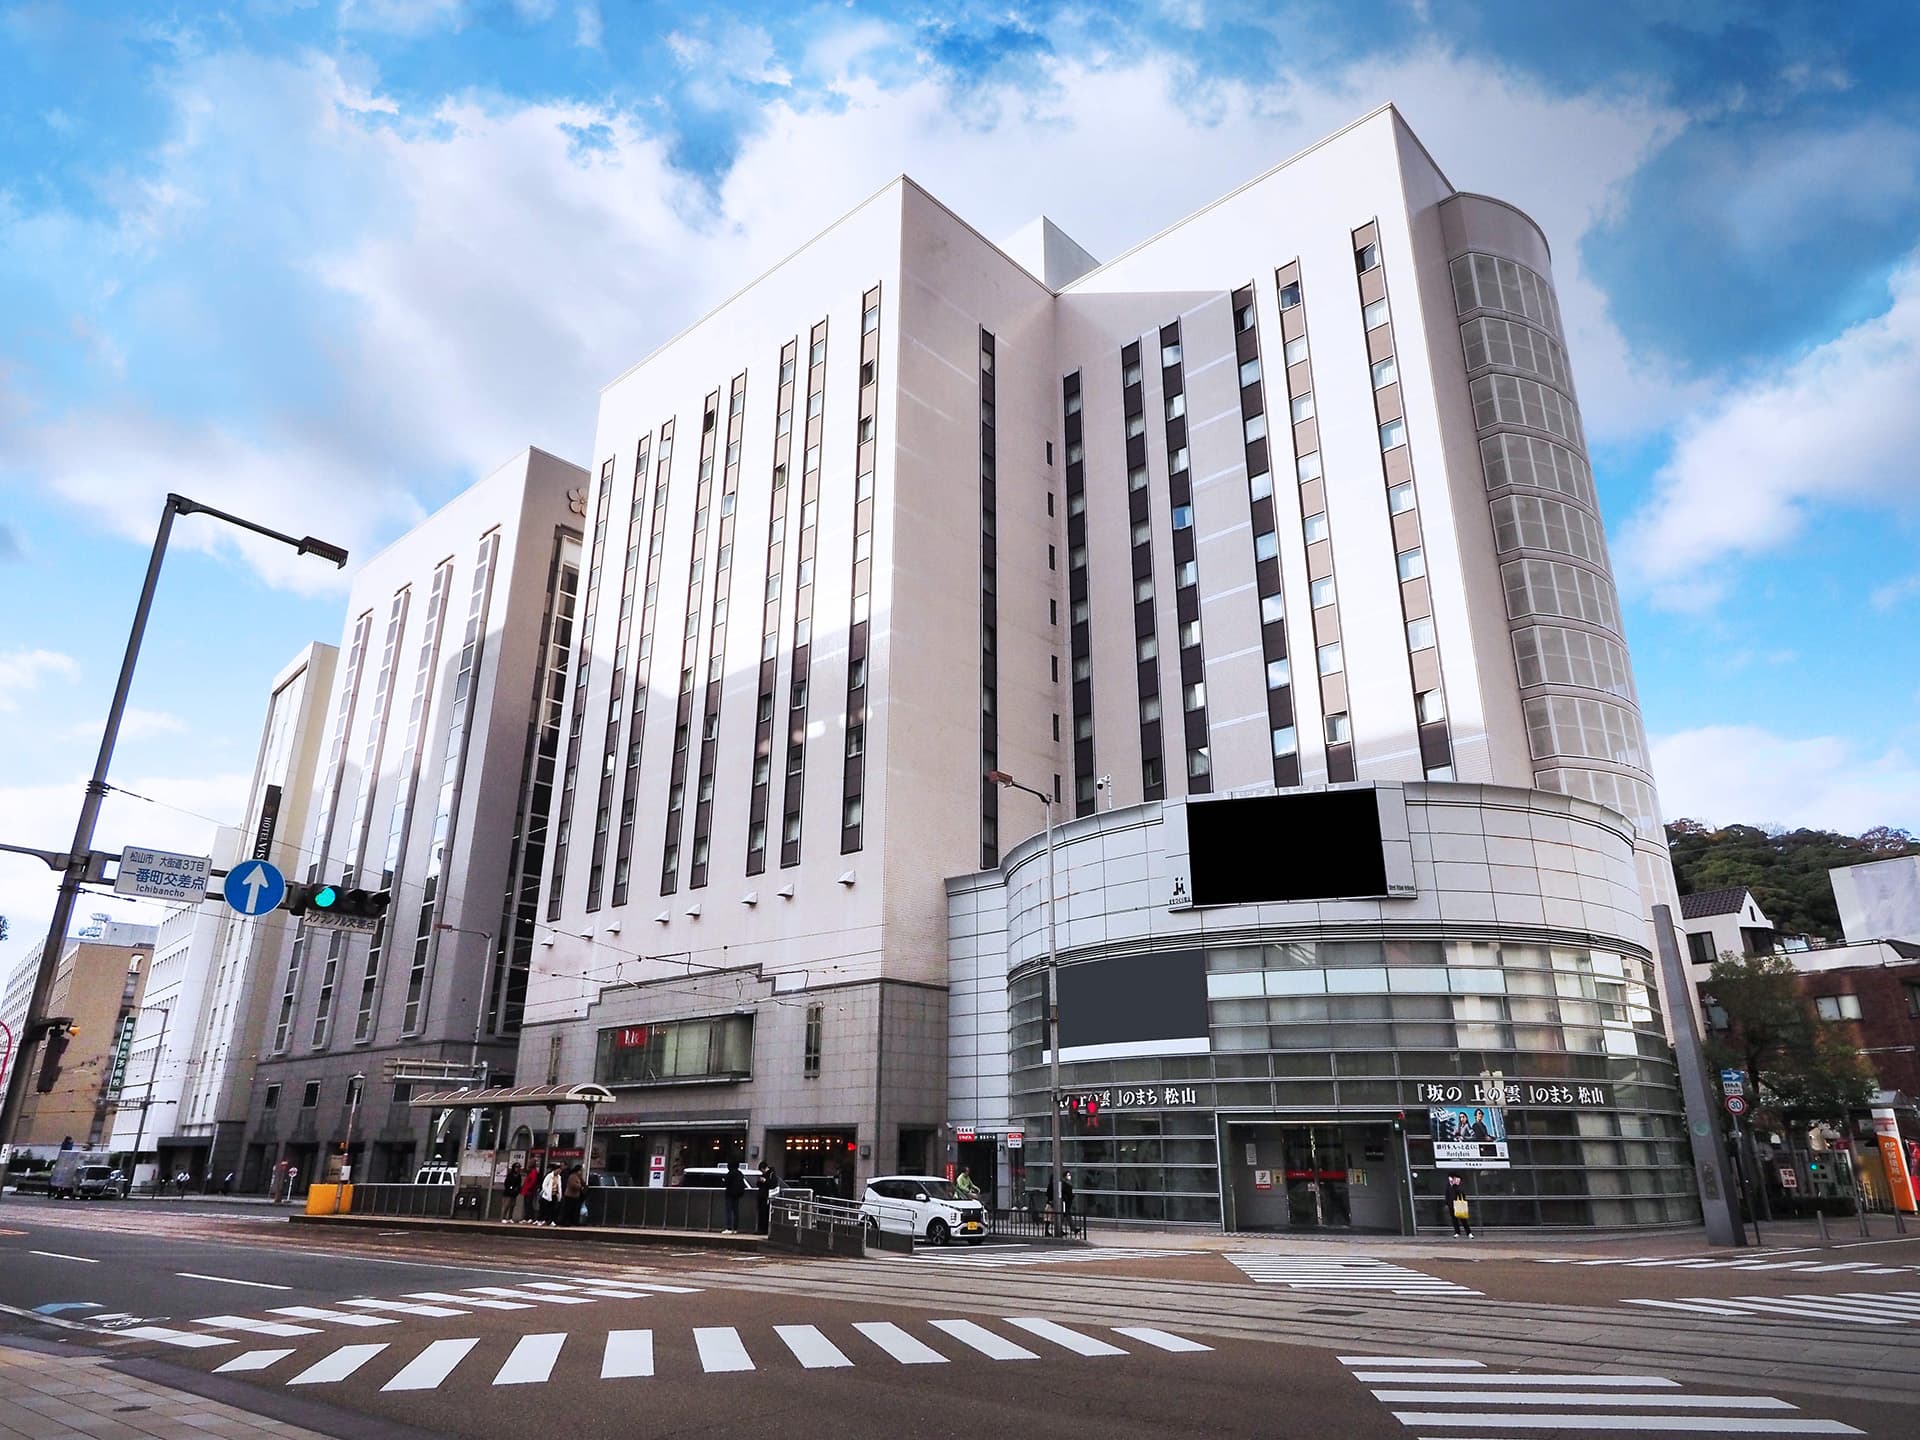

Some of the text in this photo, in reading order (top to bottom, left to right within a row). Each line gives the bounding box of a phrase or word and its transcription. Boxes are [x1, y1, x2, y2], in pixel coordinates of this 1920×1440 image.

[259, 816, 273, 842] HOTEL
[129, 851, 205, 873] 松山市 大街道3丁目
[121, 867, 206, 890] 一番町交差点
[135, 884, 186, 898] Ichibancho
[1730, 1100, 1741, 1110] 30
